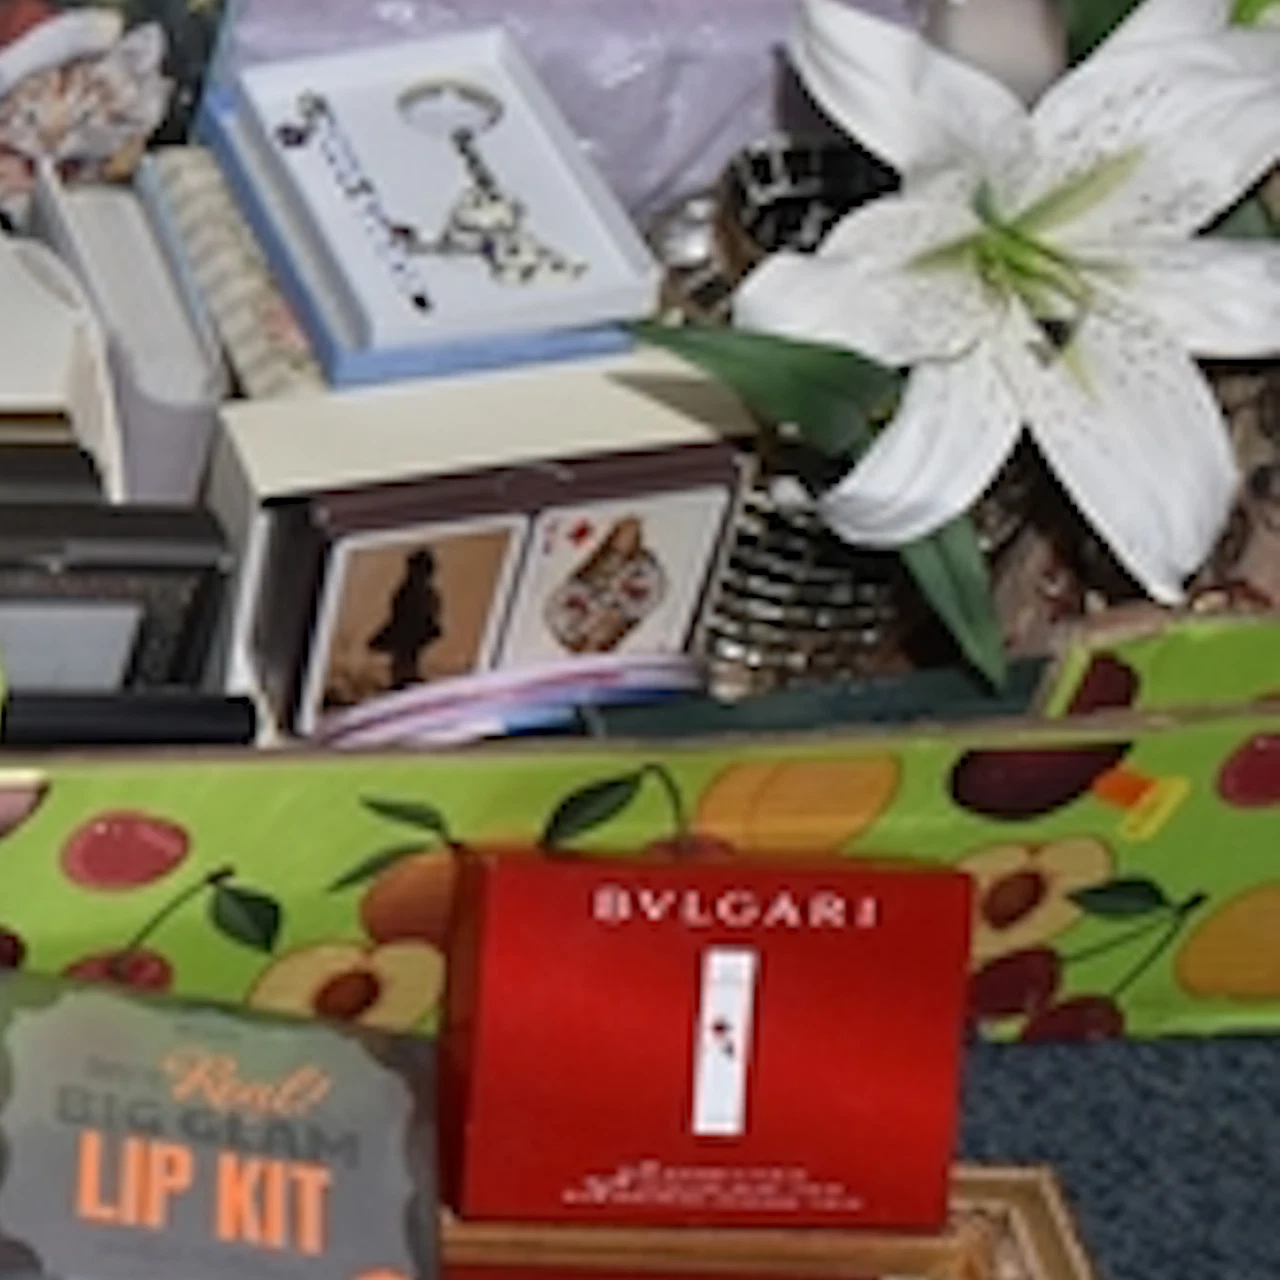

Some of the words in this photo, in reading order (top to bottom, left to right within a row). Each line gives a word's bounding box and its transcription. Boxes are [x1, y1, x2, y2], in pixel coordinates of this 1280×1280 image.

[592, 883, 878, 929] BVLGARI
[75, 1127, 195, 1231] LIP
[214, 1150, 333, 1258] KIT
